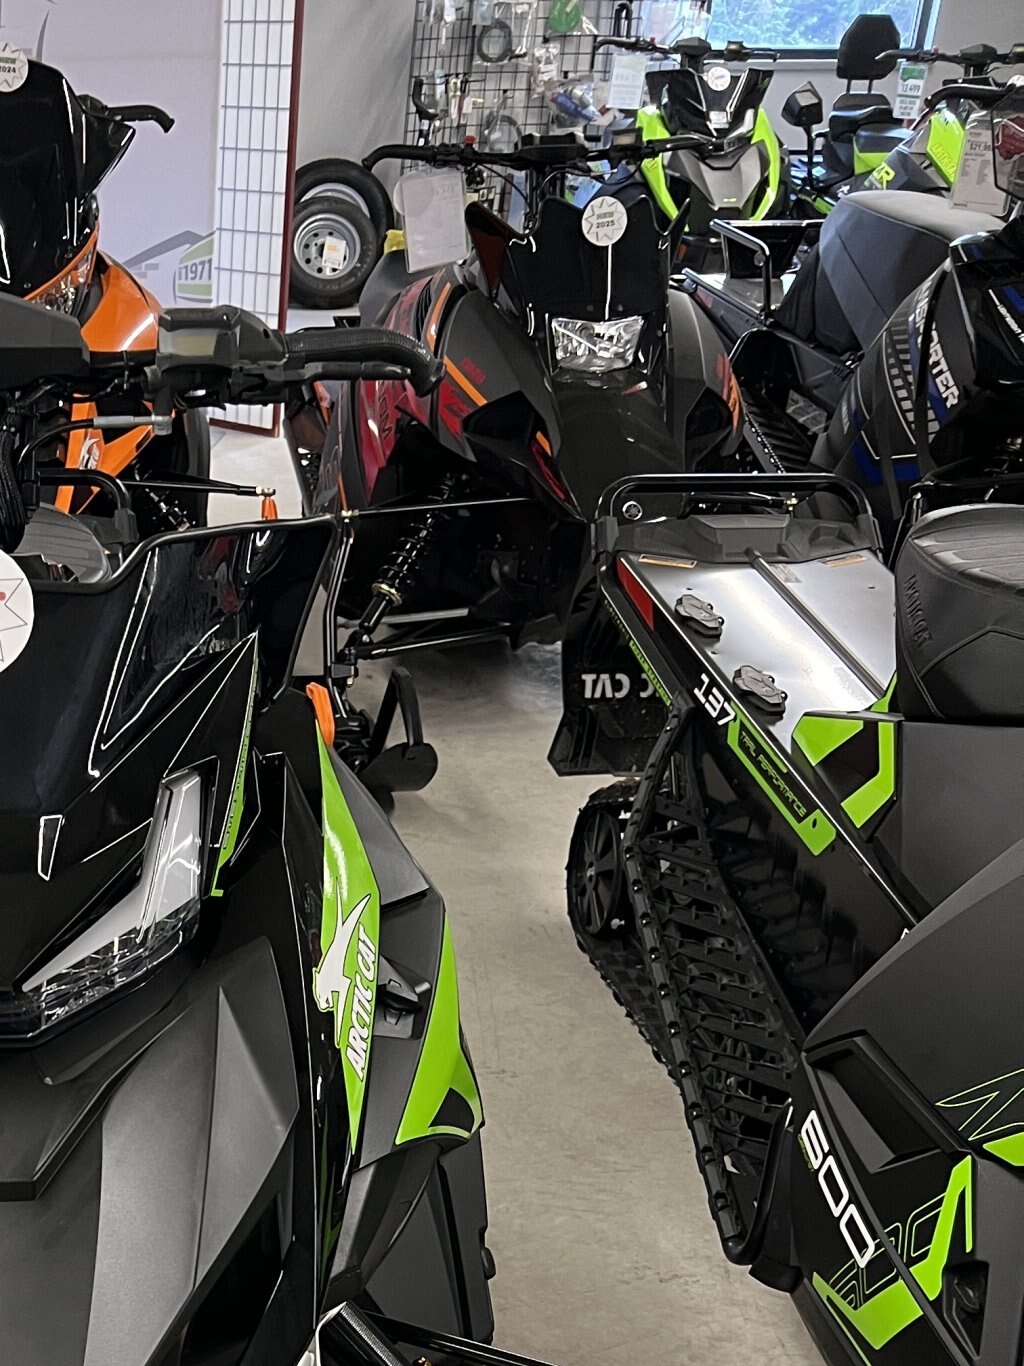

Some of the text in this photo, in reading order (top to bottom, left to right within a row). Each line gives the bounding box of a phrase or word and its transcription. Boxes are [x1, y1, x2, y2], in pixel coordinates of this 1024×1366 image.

[595, 219, 616, 229] 2025
[184, 257, 213, 281] 1971
[693, 673, 737, 726] 137
[345, 921, 377, 1082] ARCTIC CAT
[800, 1109, 876, 1269] 600
